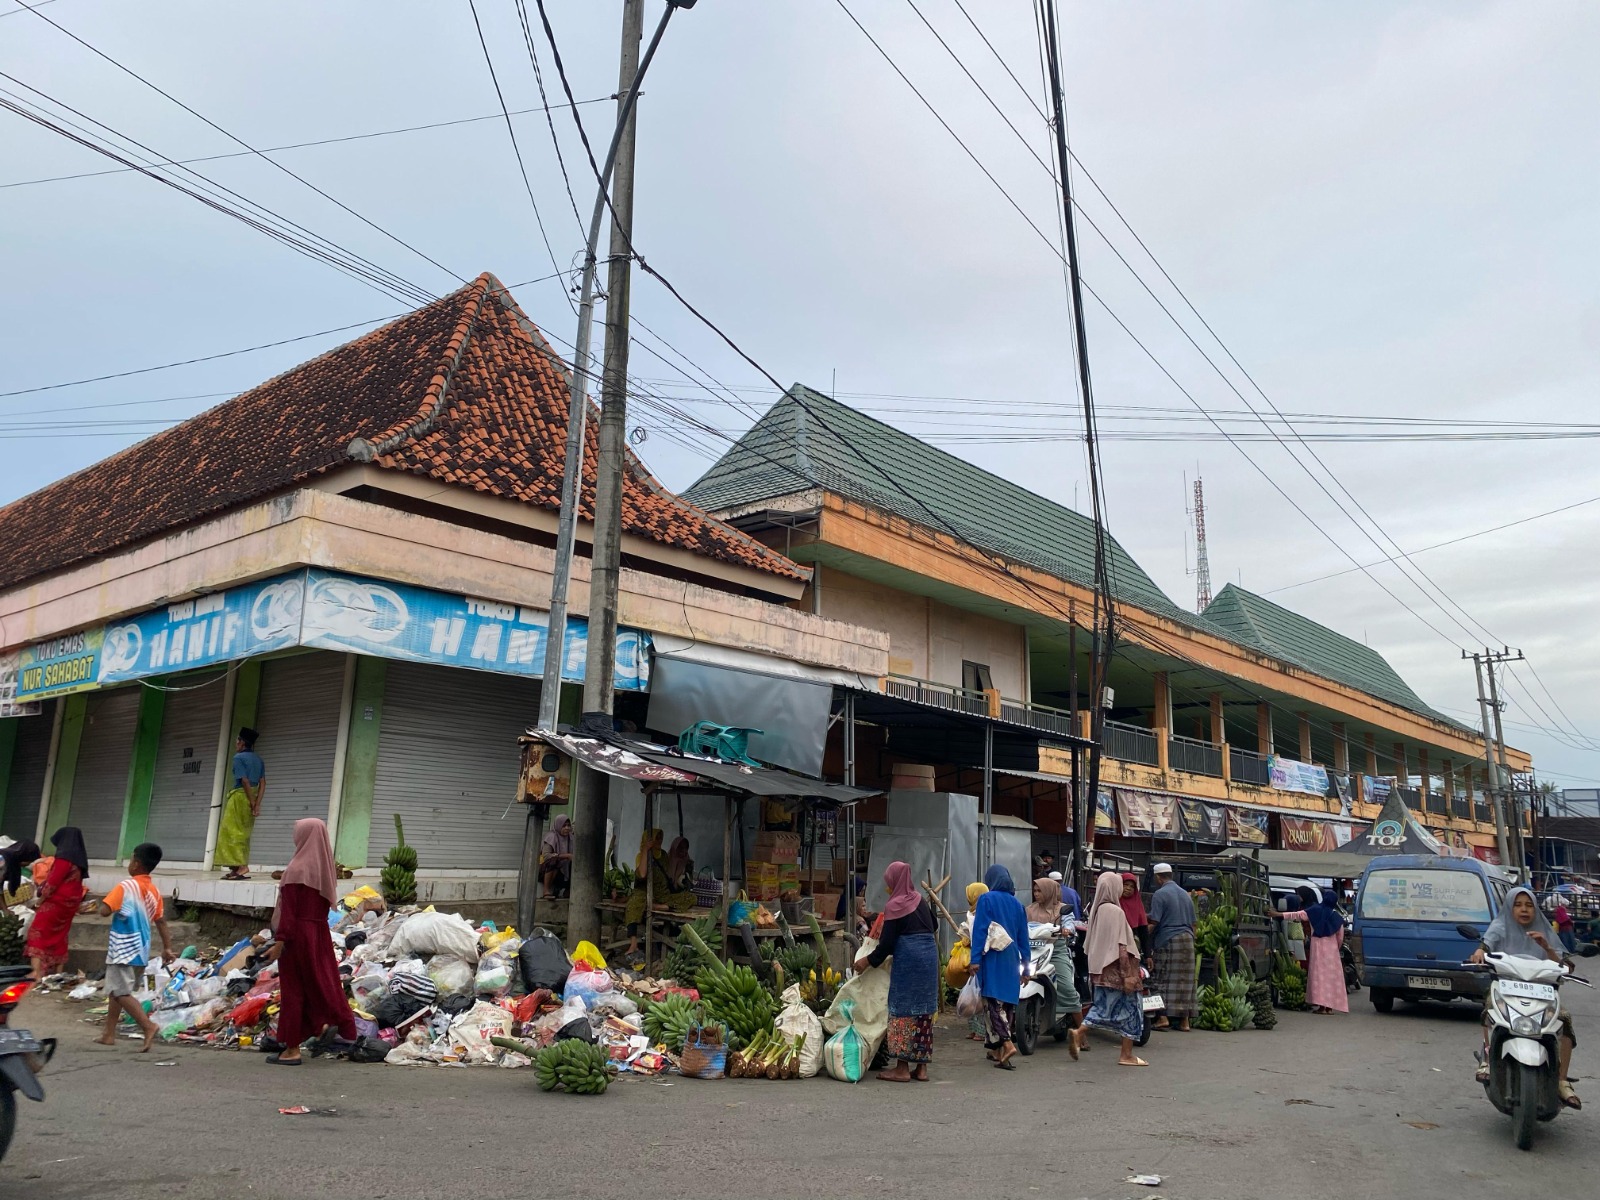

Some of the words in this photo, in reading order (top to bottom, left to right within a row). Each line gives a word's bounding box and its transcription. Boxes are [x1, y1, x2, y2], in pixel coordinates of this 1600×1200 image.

[465, 597, 516, 621] TOKO
[36, 640, 57, 661] TOKO
[59, 632, 85, 656] EMAS
[150, 612, 240, 668] HANIF
[430, 617, 588, 672] HANF
[22, 667, 42, 692] NUR
[44, 655, 95, 688] SAHABAT
[1365, 834, 1408, 846] TOP
[1433, 888, 1473, 896] SURFACE
